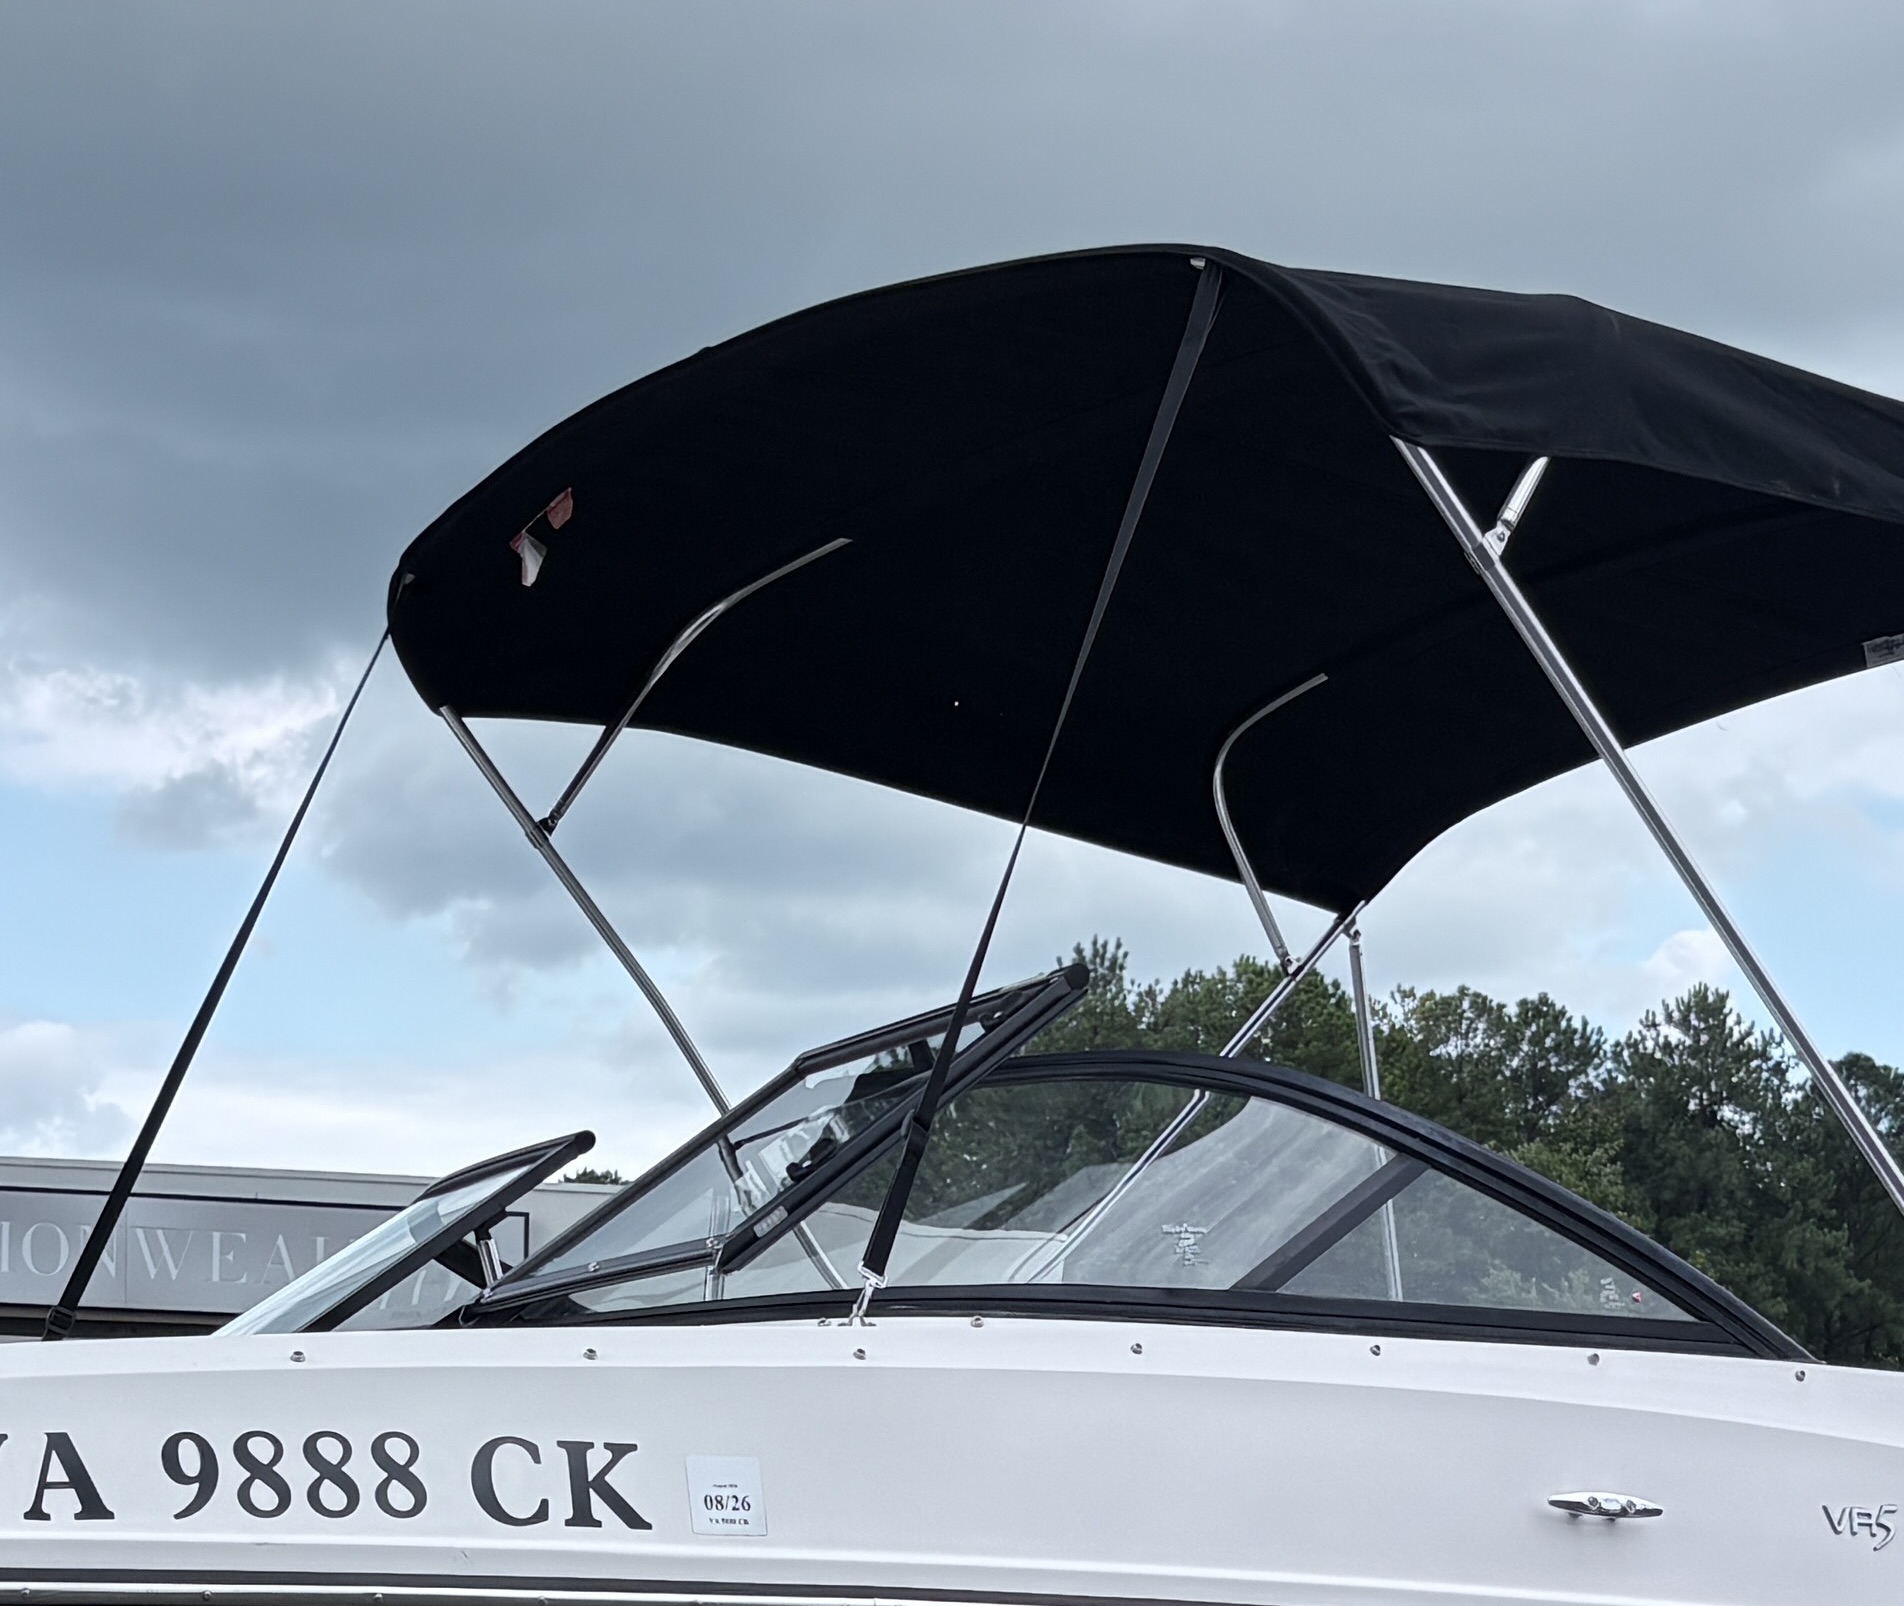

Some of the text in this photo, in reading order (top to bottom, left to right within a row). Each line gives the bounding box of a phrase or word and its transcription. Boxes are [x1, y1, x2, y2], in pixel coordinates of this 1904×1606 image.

[161, 1430, 428, 1520] 9888
[470, 1436, 653, 1531] CK
[703, 1494, 751, 1511] 08/26
[1822, 1503, 1898, 1552] VR5
